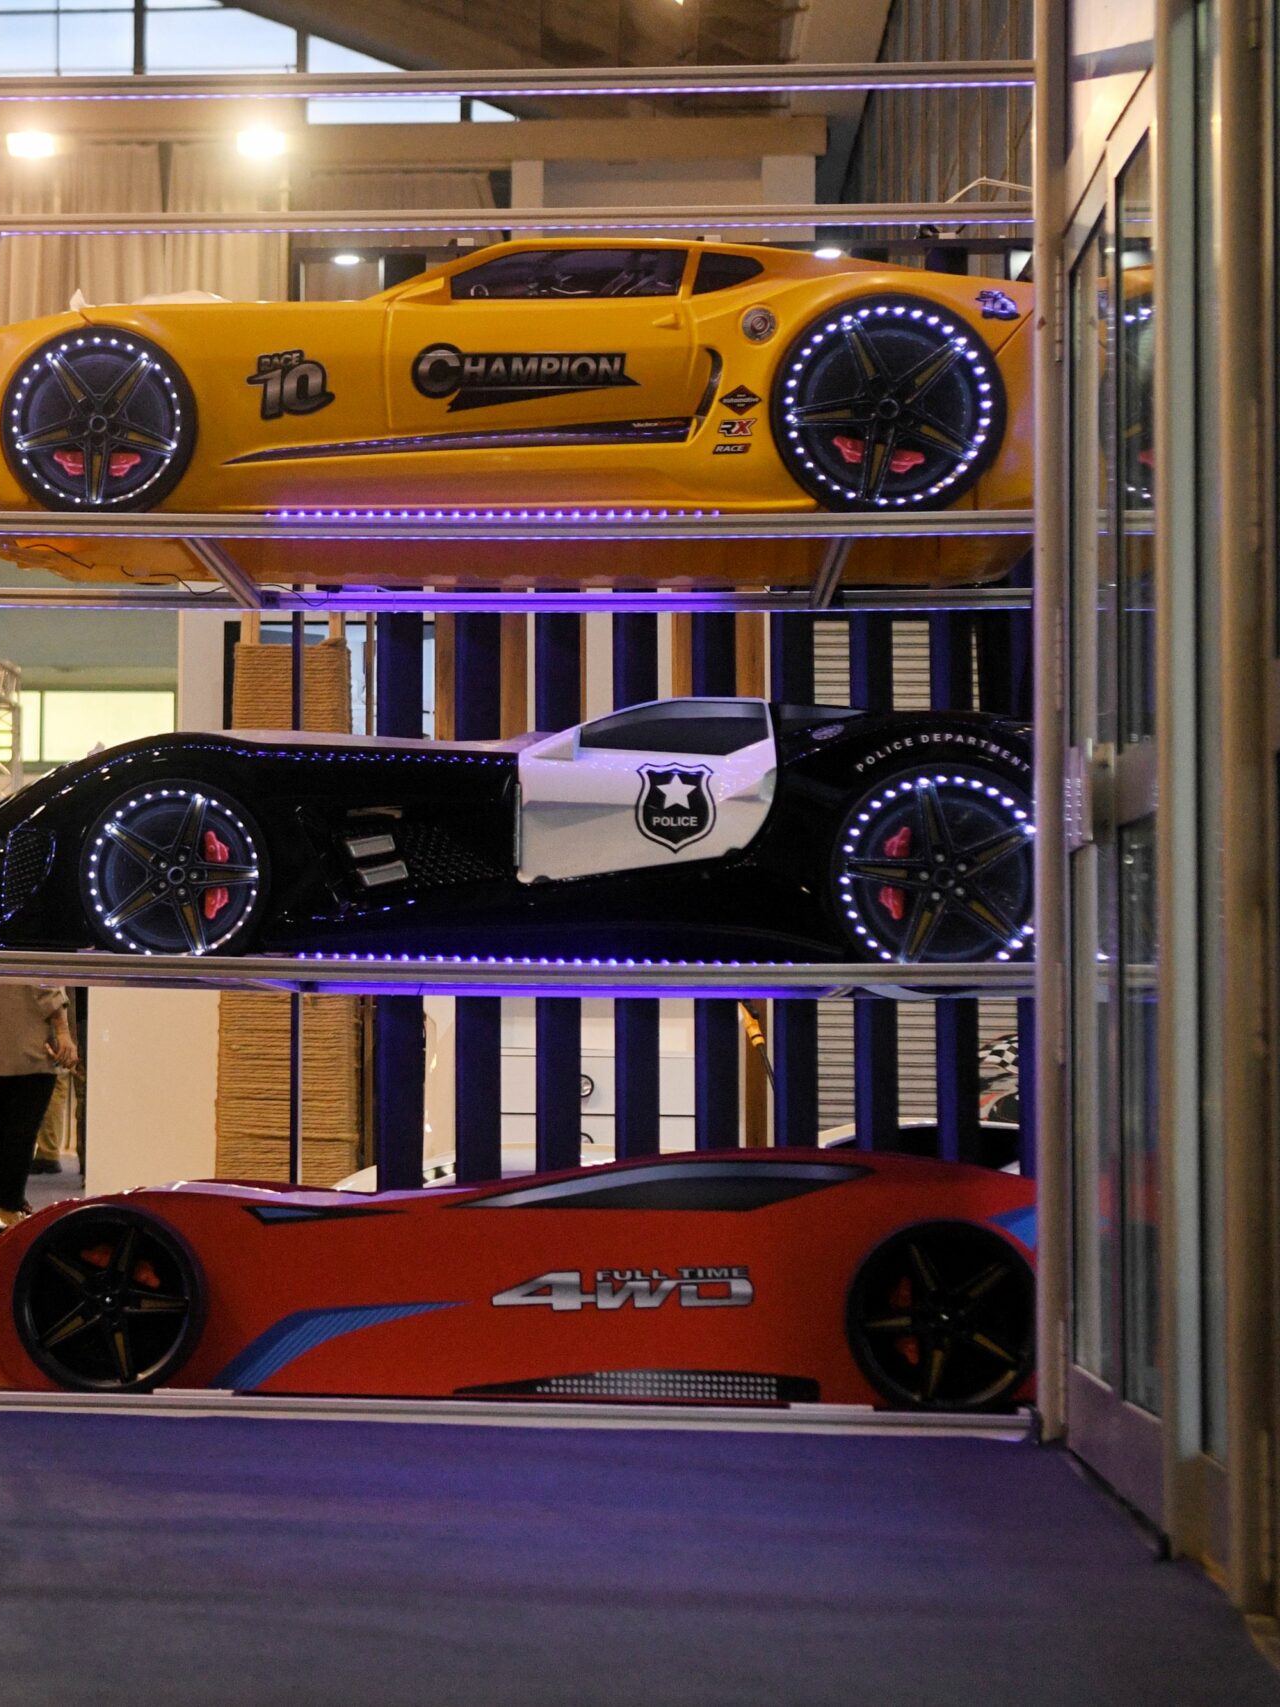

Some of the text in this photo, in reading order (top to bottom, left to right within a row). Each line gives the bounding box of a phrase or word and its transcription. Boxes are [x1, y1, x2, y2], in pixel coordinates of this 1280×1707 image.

[261, 353, 301, 371] RACE
[416, 347, 623, 394] CHAMPION
[248, 361, 334, 419] 10
[719, 419, 757, 436] RX
[715, 444, 745, 453] RACE
[854, 732, 1032, 773] POLICE DEPARTMENT
[652, 816, 699, 827] POLICE
[596, 1266, 749, 1282] FULL TIME
[491, 1270, 755, 1312] 4WD
